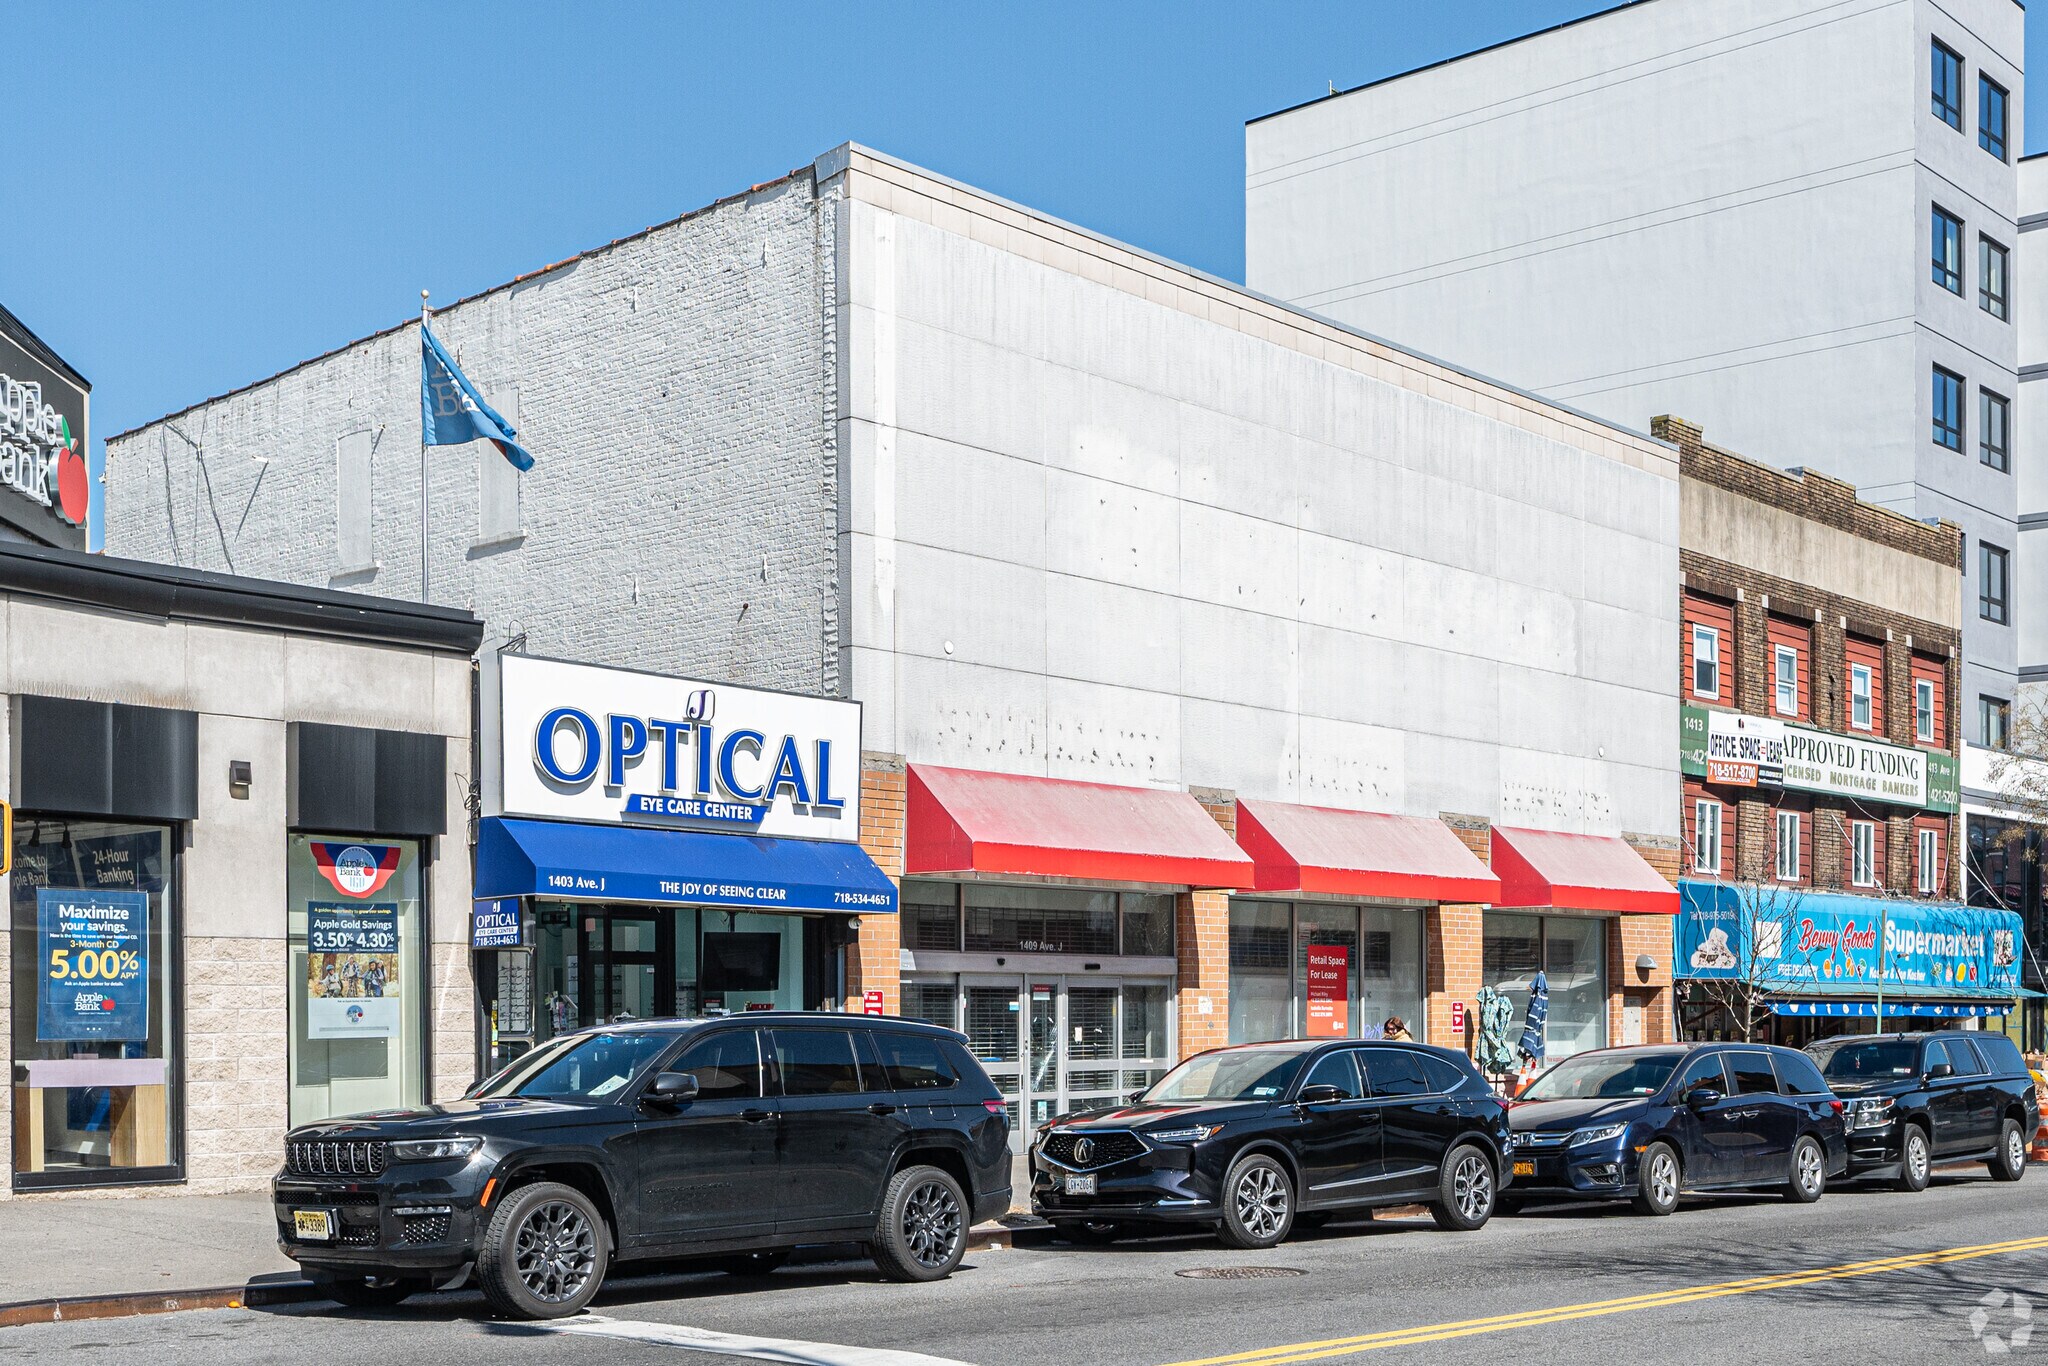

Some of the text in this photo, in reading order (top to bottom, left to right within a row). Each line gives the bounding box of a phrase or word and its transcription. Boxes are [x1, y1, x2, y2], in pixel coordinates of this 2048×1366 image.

[0, 373, 57, 446] pple
[0, 441, 52, 507] ank
[1685, 717, 1703, 731] 1413
[1710, 733, 1737, 758] OFFICE
[1739, 736, 1760, 760] SPACE
[534, 705, 847, 809] OPTICAL
[1861, 748, 1919, 780] FUNDING
[1709, 763, 1756, 779] 718-517-8700
[1784, 763, 1822, 783] ICENSED
[1829, 771, 1877, 790] MORTGAGE
[1882, 780, 1919, 797] BANKERS
[640, 796, 753, 821] EYE CARE CENTER
[92, 848, 129, 865] 24-Hour
[340, 858, 365, 869] Apple
[28, 871, 51, 886] Bank
[96, 866, 135, 885] Banking
[340, 867, 362, 877] Bank
[548, 875, 606, 891] 1403 Ave. J
[659, 881, 787, 900] THE JOY OF SEEING CLEAR
[834, 892, 891, 906] 718-534-4651
[59, 904, 129, 920] Maximize
[60, 921, 128, 934] your savings.
[314, 919, 392, 931] Apple Gold Savings
[476, 913, 517, 928] OPTICAL
[70, 940, 119, 949] 3-Month CD
[313, 931, 395, 948] 3.50% 4.30%
[476, 935, 518, 946] 718-534-4651
[1019, 940, 1063, 952] 1409 Ave. J
[1842, 920, 1877, 957] Goods
[1885, 919, 1984, 961] Supermarket
[50, 949, 139, 979] 5.00%
[1310, 955, 1346, 967] Retail Space
[1310, 970, 1338, 980] For Lease
[1907, 968, 1926, 981] Kosher
[75, 992, 103, 1004] Apple
[74, 1002, 100, 1011] Bank
